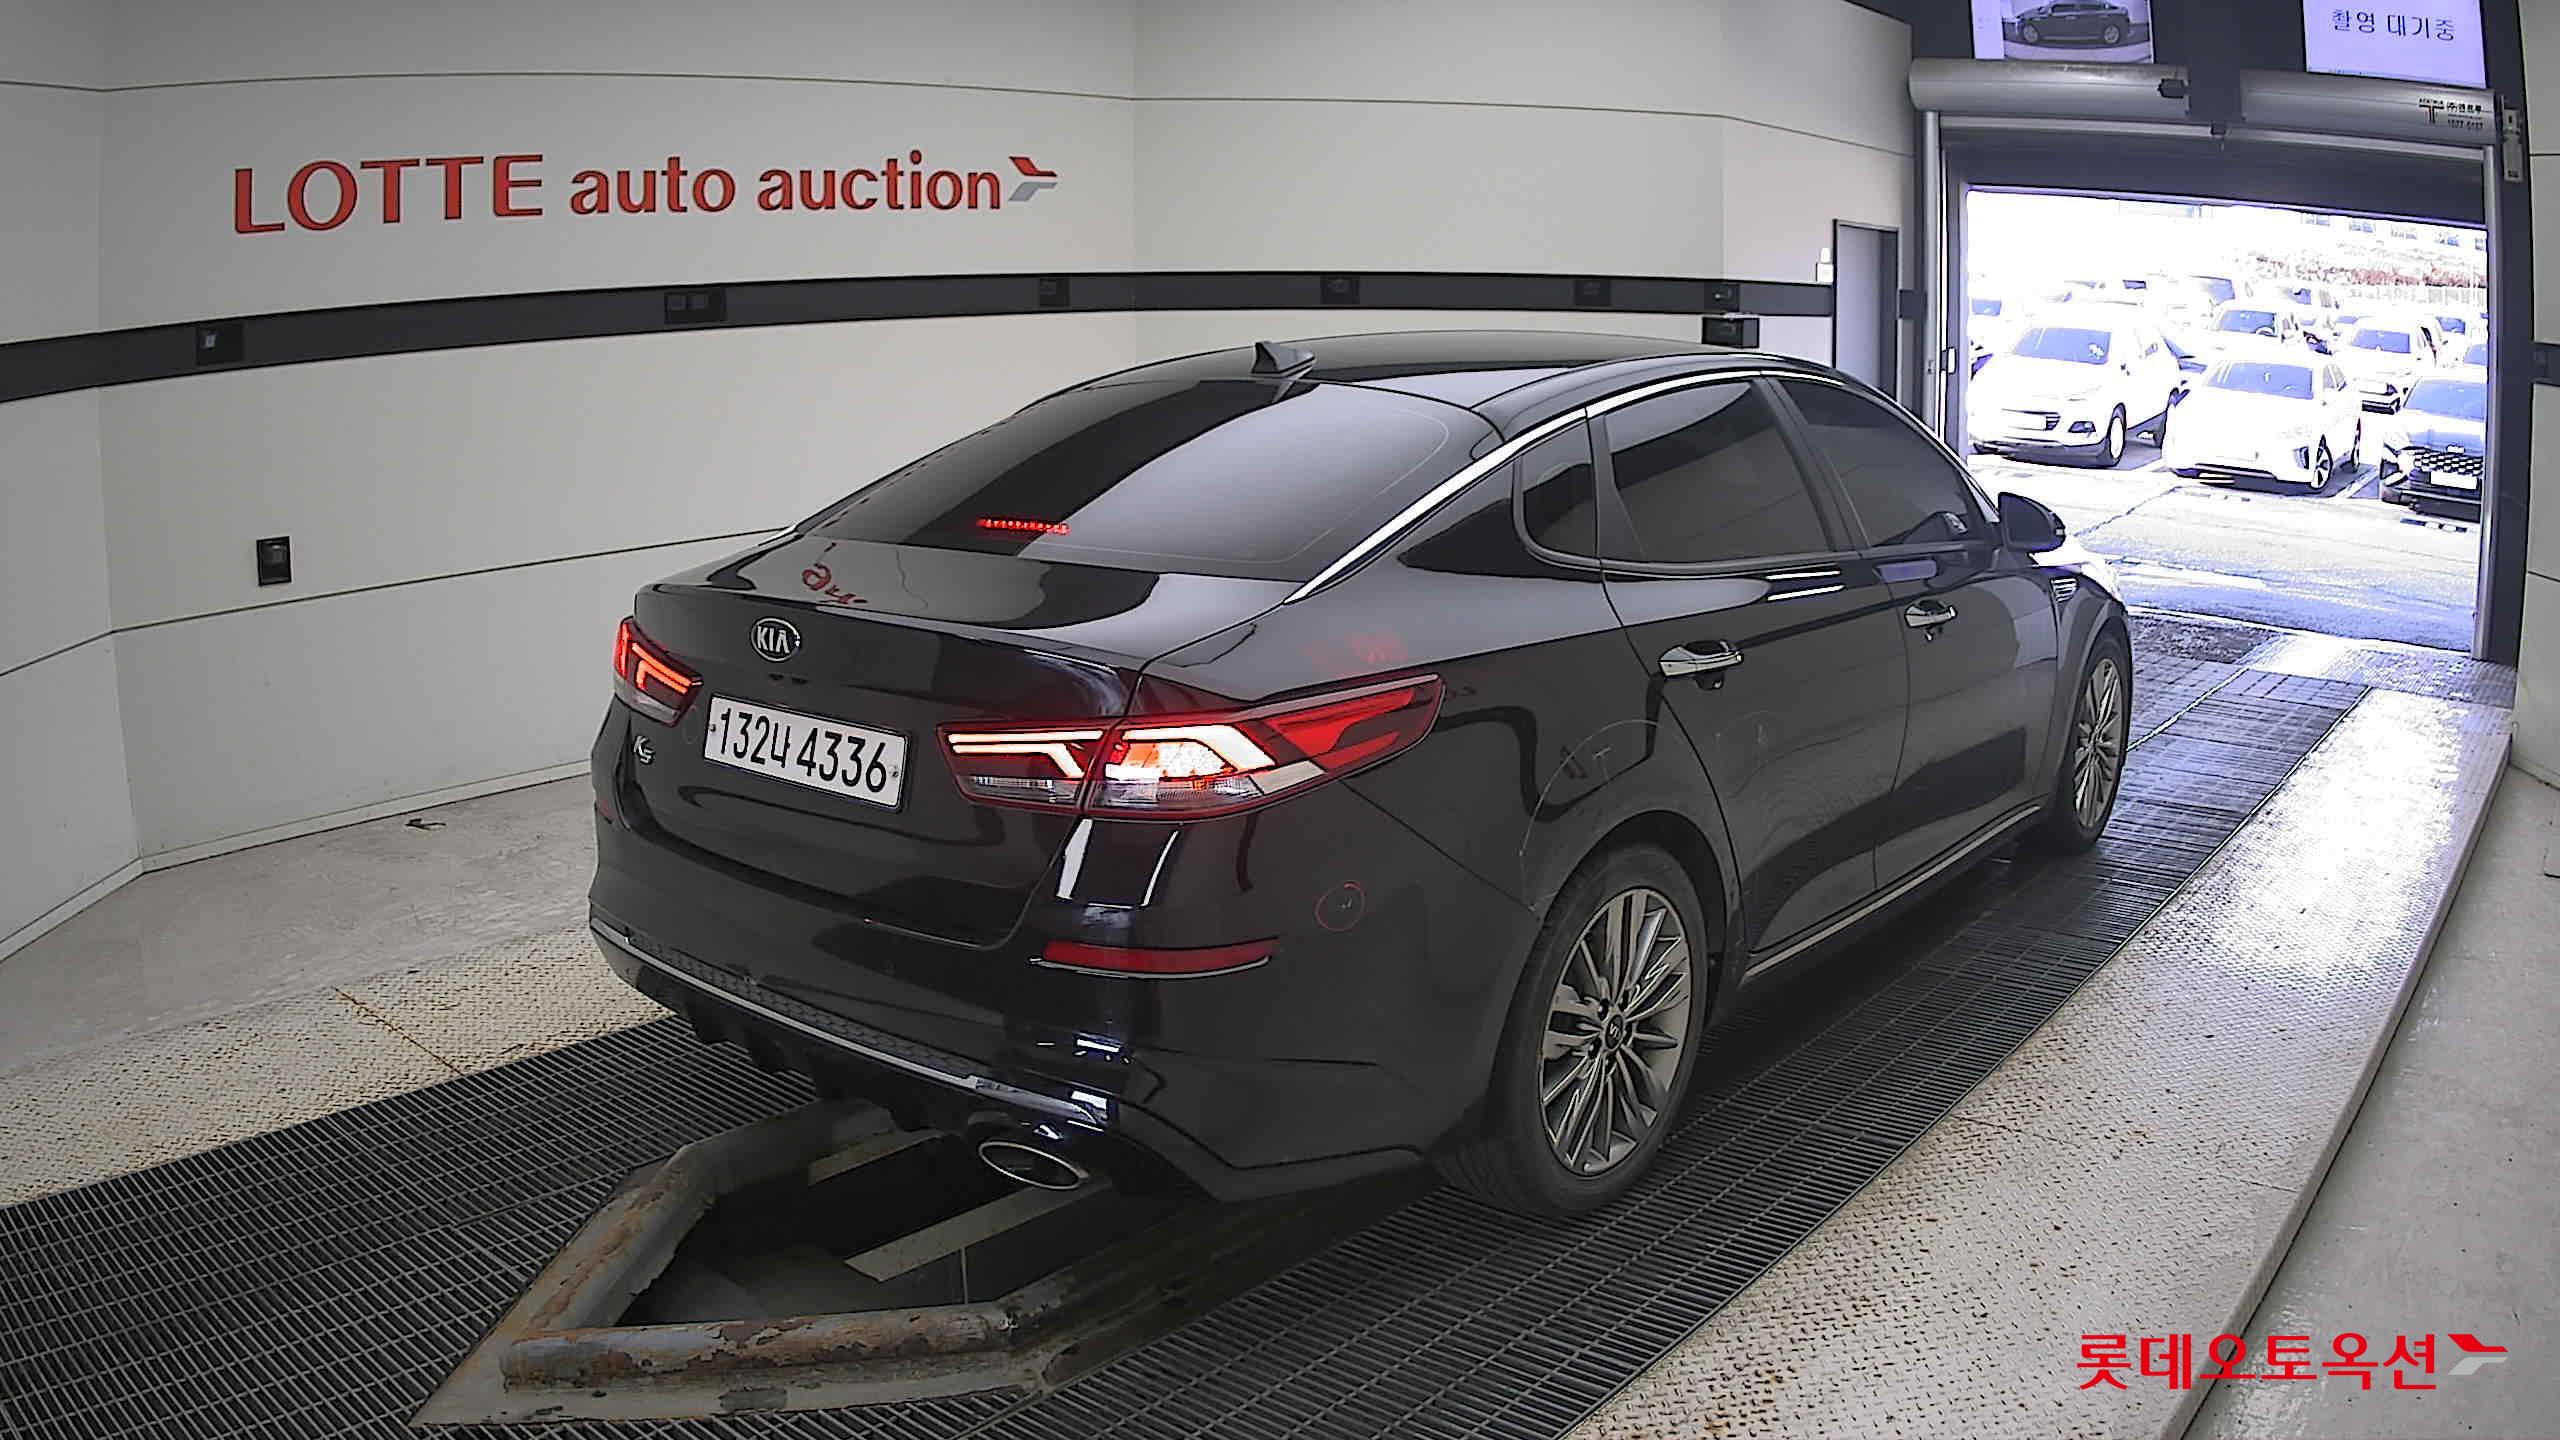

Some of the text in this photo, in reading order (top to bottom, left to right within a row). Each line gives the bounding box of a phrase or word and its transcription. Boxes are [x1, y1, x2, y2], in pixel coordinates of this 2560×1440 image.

[2387, 14, 2456, 42] 대기중
[234, 150, 1003, 233] LOTTE auto auction
[757, 625, 790, 654] KIA
[720, 707, 888, 793] 132나 4336
